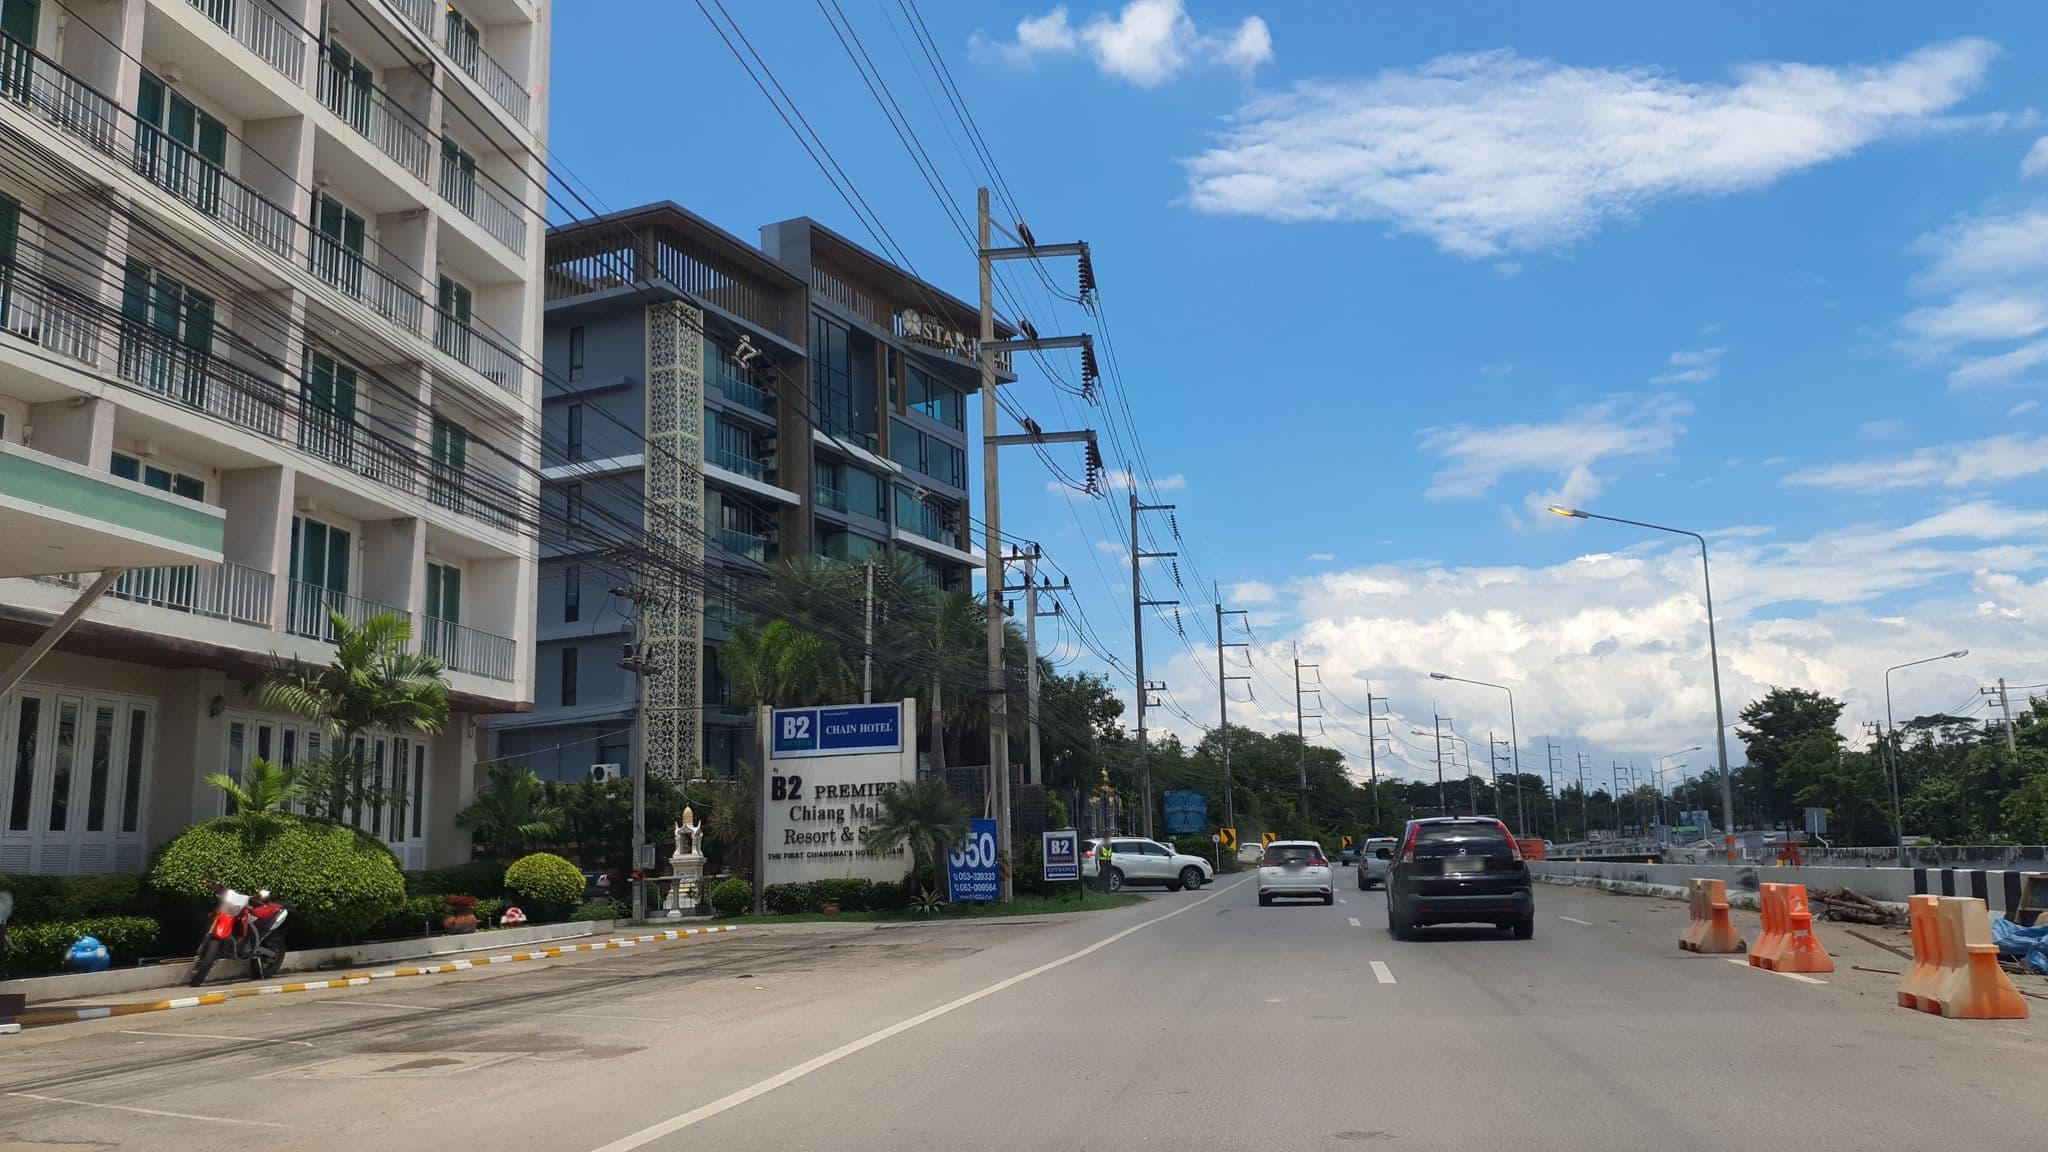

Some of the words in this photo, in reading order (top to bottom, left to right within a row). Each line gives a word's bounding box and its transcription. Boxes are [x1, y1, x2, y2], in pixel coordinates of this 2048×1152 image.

[783, 716, 810, 740] B2
[826, 725, 857, 735] CHAIN
[860, 722, 893, 734] HOTEL
[771, 775, 803, 801] B2
[789, 805, 846, 824] Chiang
[850, 802, 879, 820] Mai
[784, 827, 836, 845] Resort
[840, 826, 855, 842] &
[768, 852, 782, 860] THE
[783, 851, 804, 860] FIRST
[1051, 840, 1070, 855] B2
